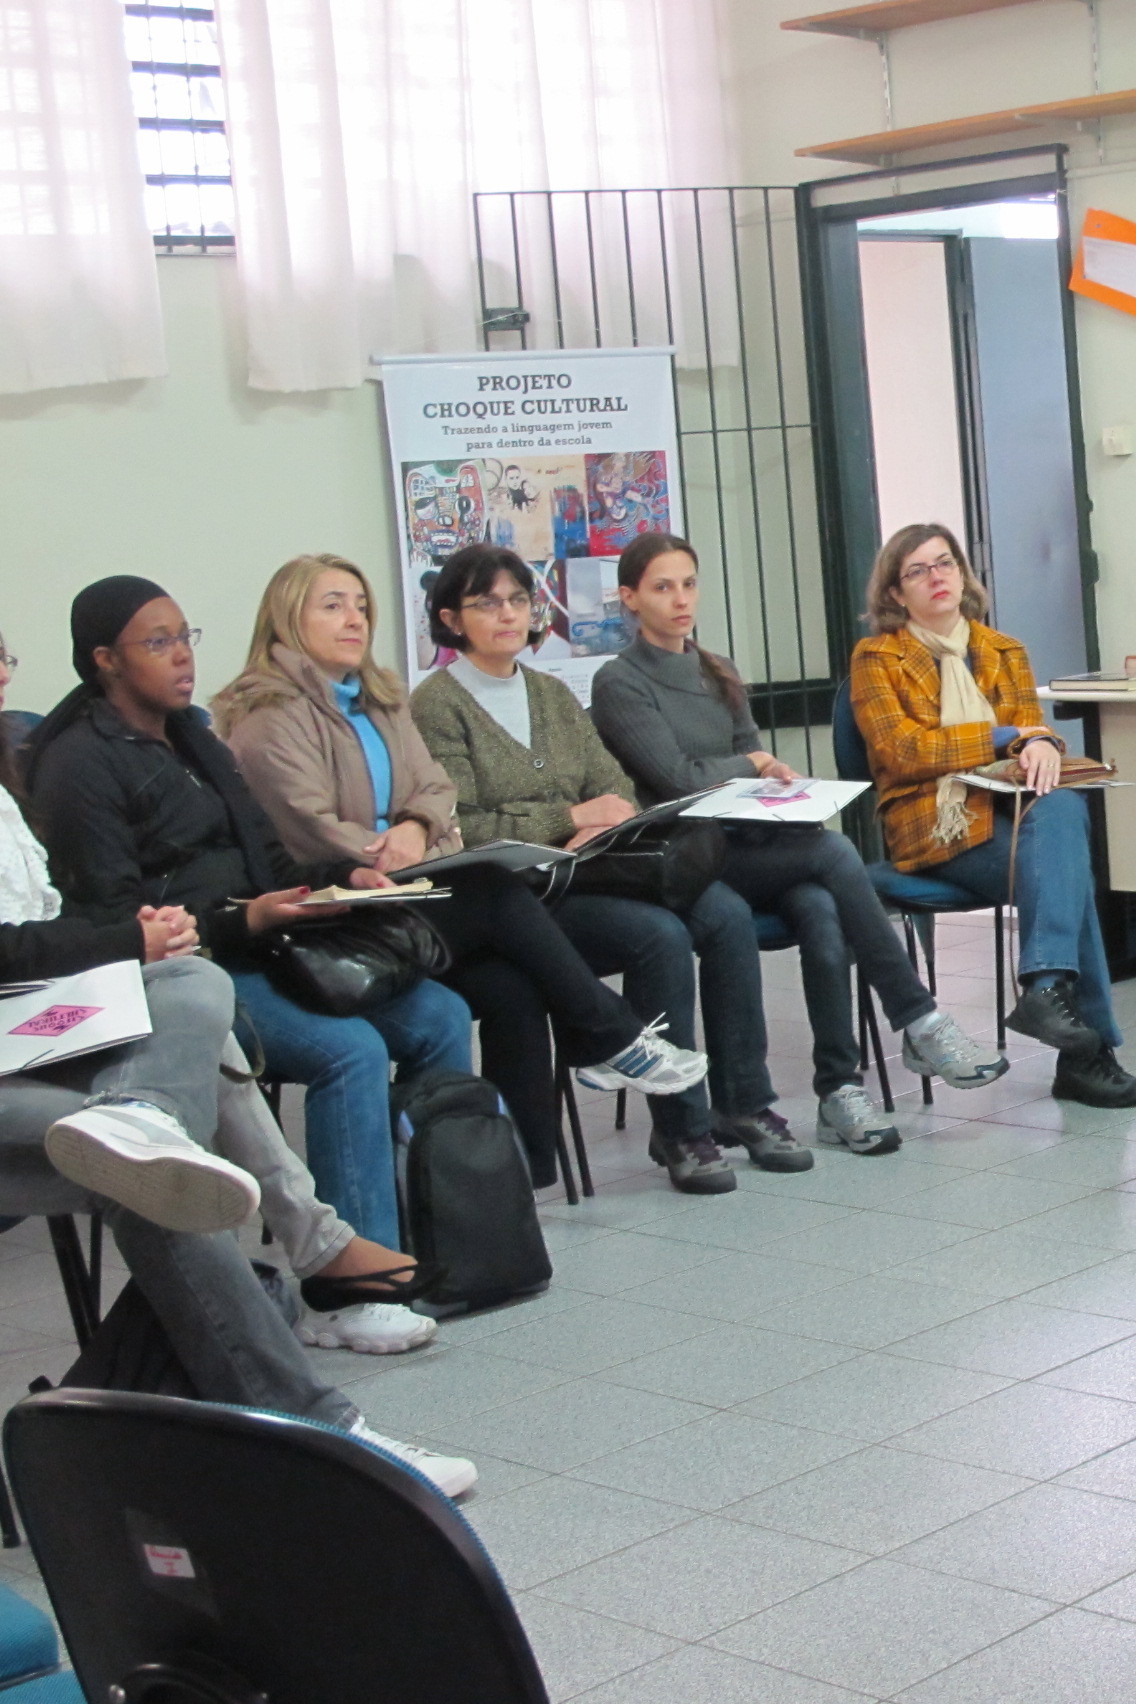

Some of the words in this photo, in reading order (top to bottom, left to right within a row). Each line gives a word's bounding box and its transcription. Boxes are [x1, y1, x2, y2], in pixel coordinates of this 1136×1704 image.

[477, 373, 572, 394] PROJETO
[423, 400, 515, 420] CHOQUE
[521, 396, 629, 415] CULTURAL
[442, 423, 498, 436] Trazendo
[501, 425, 509, 433] a
[511, 421, 576, 435] linguagem
[577, 420, 613, 432] jovem
[466, 440, 493, 452] para
[496, 437, 535, 450] dentro
[537, 436, 552, 447] da
[555, 435, 592, 446] escola
